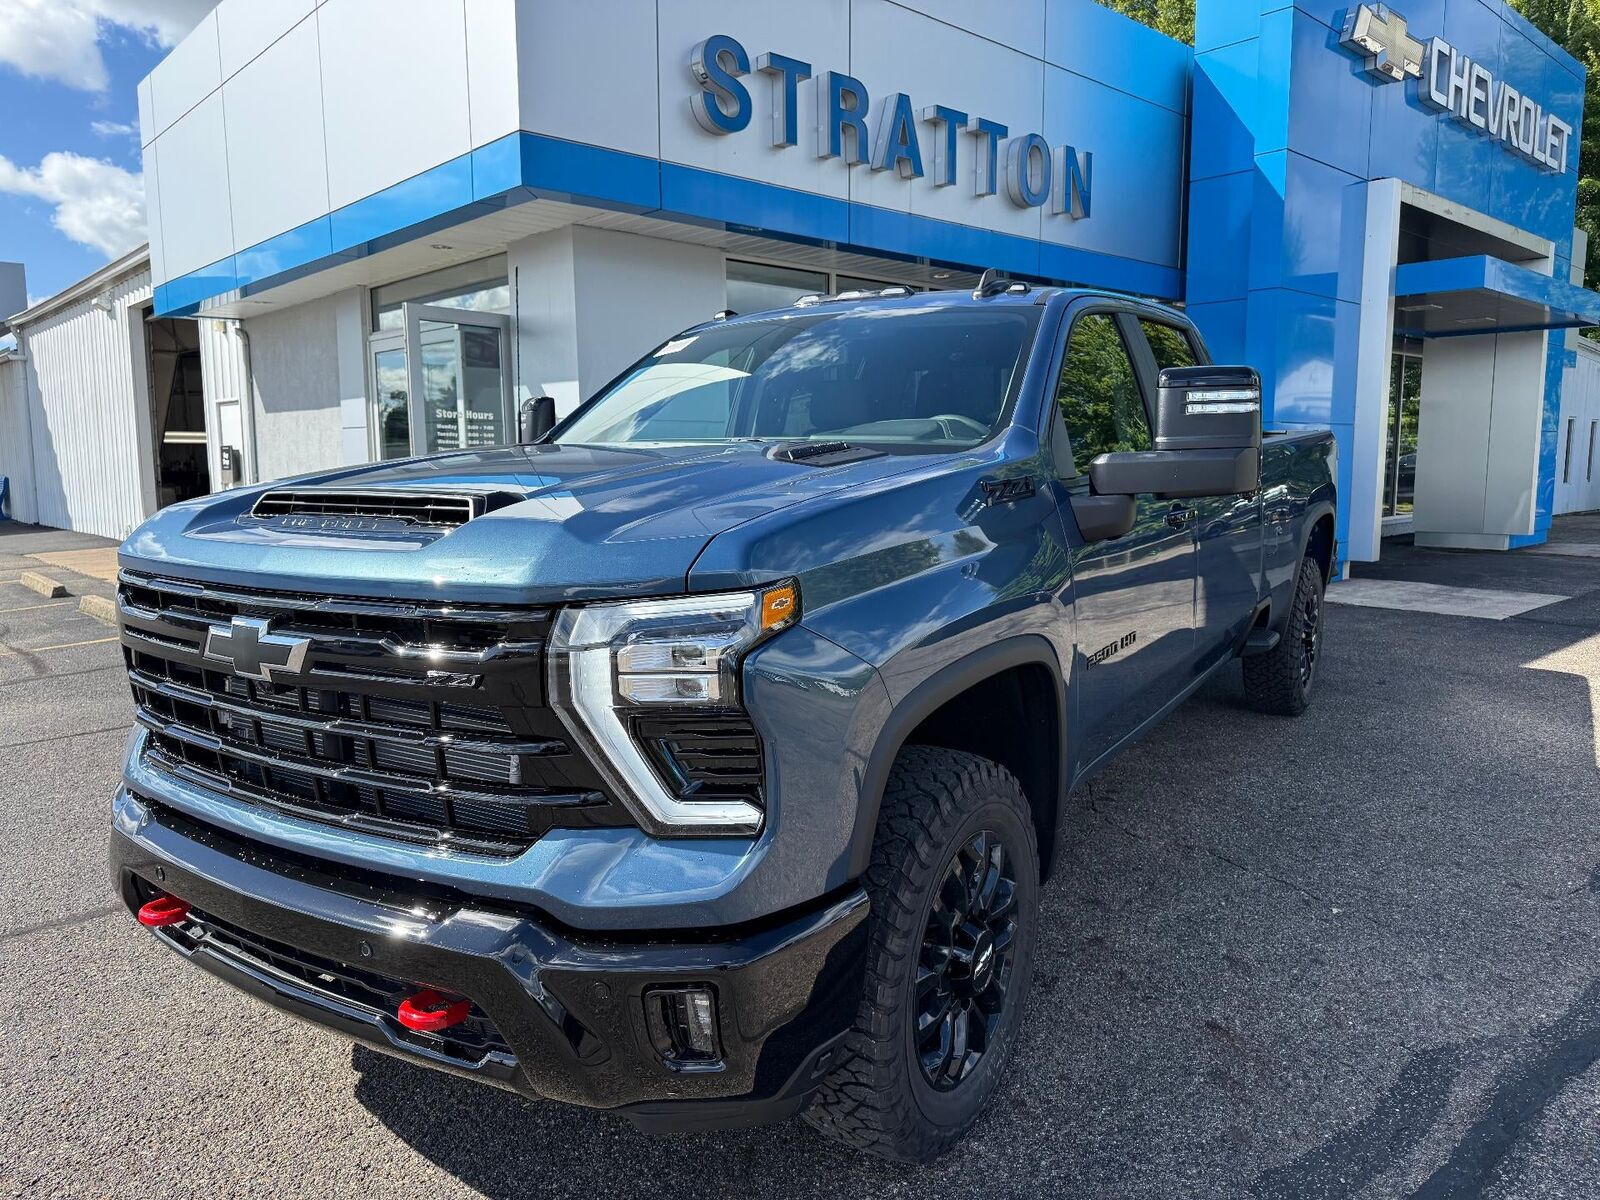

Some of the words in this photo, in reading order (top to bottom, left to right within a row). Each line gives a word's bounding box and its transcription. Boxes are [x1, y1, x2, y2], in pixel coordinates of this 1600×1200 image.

[689, 34, 1093, 220] STRATTON
[1424, 36, 1573, 174] CHEVROLET
[436, 409, 463, 418] Store
[466, 410, 494, 420] Hours
[1120, 631, 1137, 649] HD
